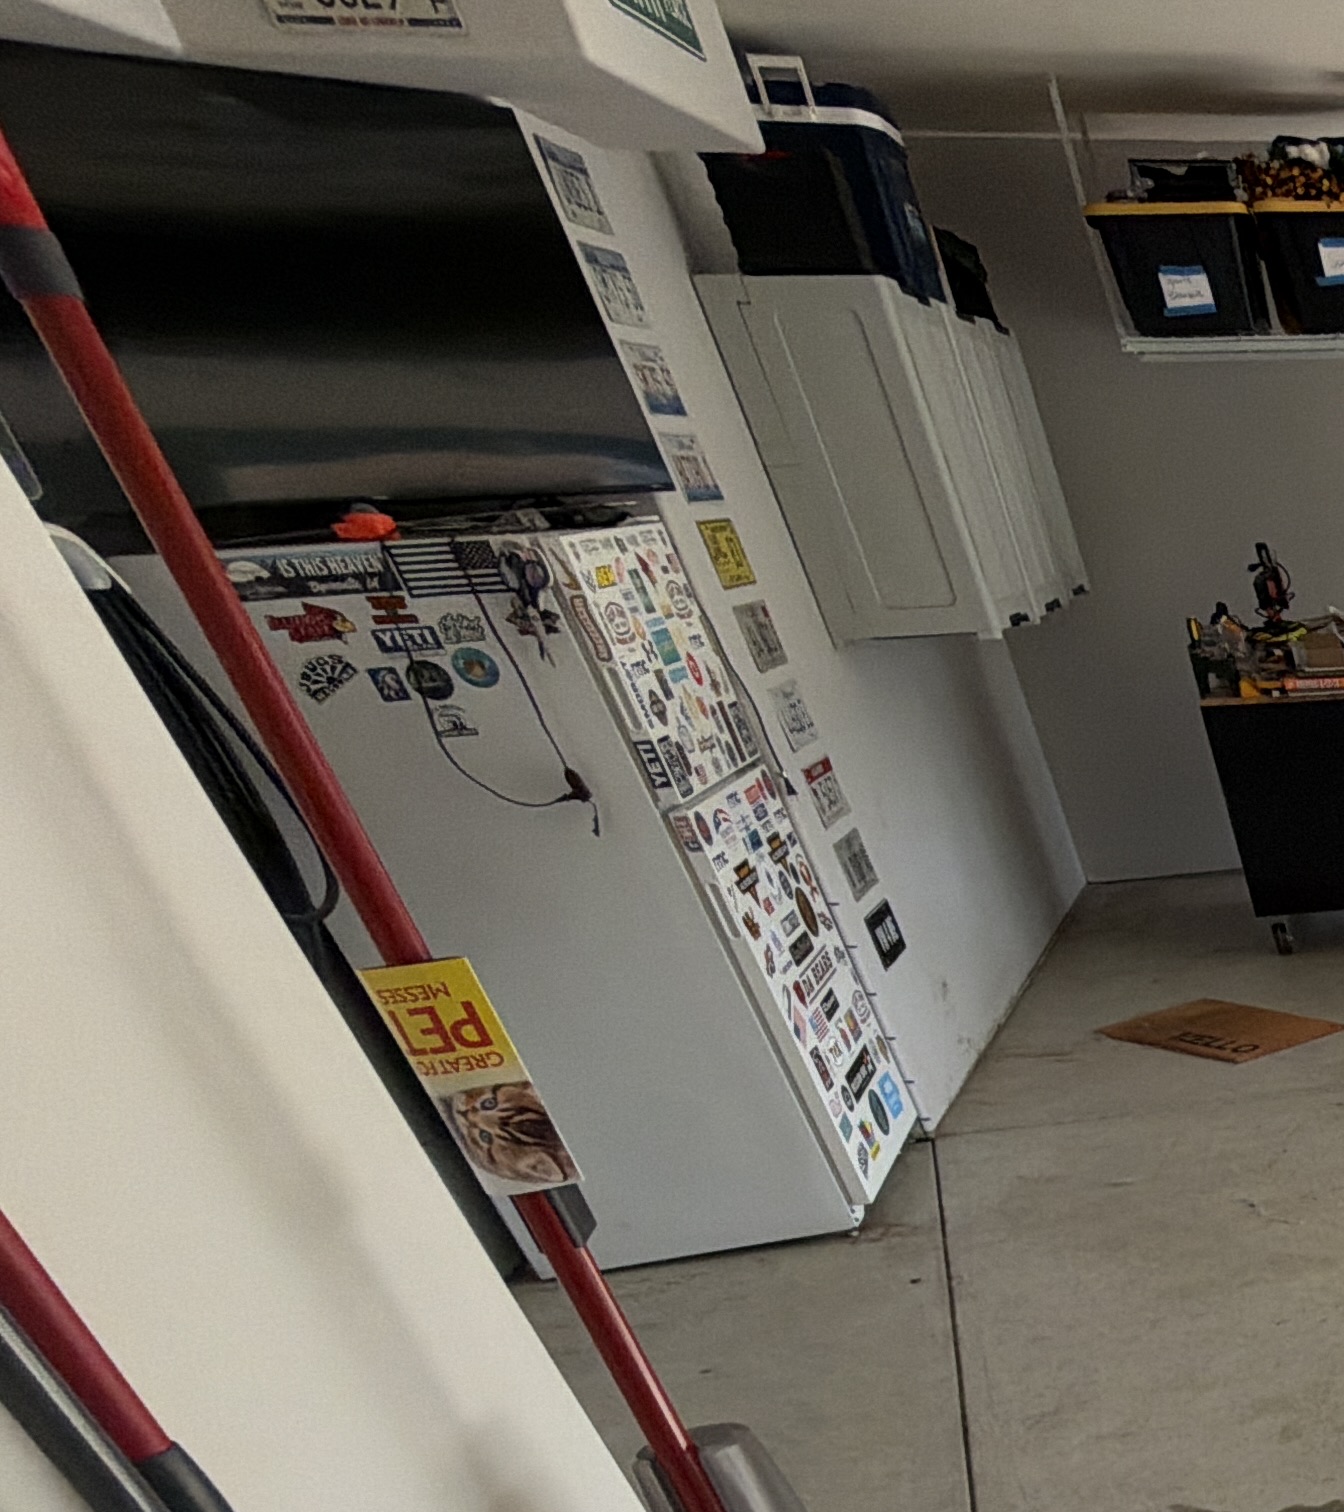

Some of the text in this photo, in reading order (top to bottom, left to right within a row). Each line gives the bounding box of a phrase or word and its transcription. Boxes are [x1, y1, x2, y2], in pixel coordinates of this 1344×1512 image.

[277, 559, 295, 578] IS
[295, 557, 326, 577] THIS
[378, 628, 435, 648] YETI
[636, 744, 668, 787] YETI
[810, 951, 833, 985] BEARS
[376, 982, 451, 1005] MESSES
[437, 1051, 505, 1074] GREAT
